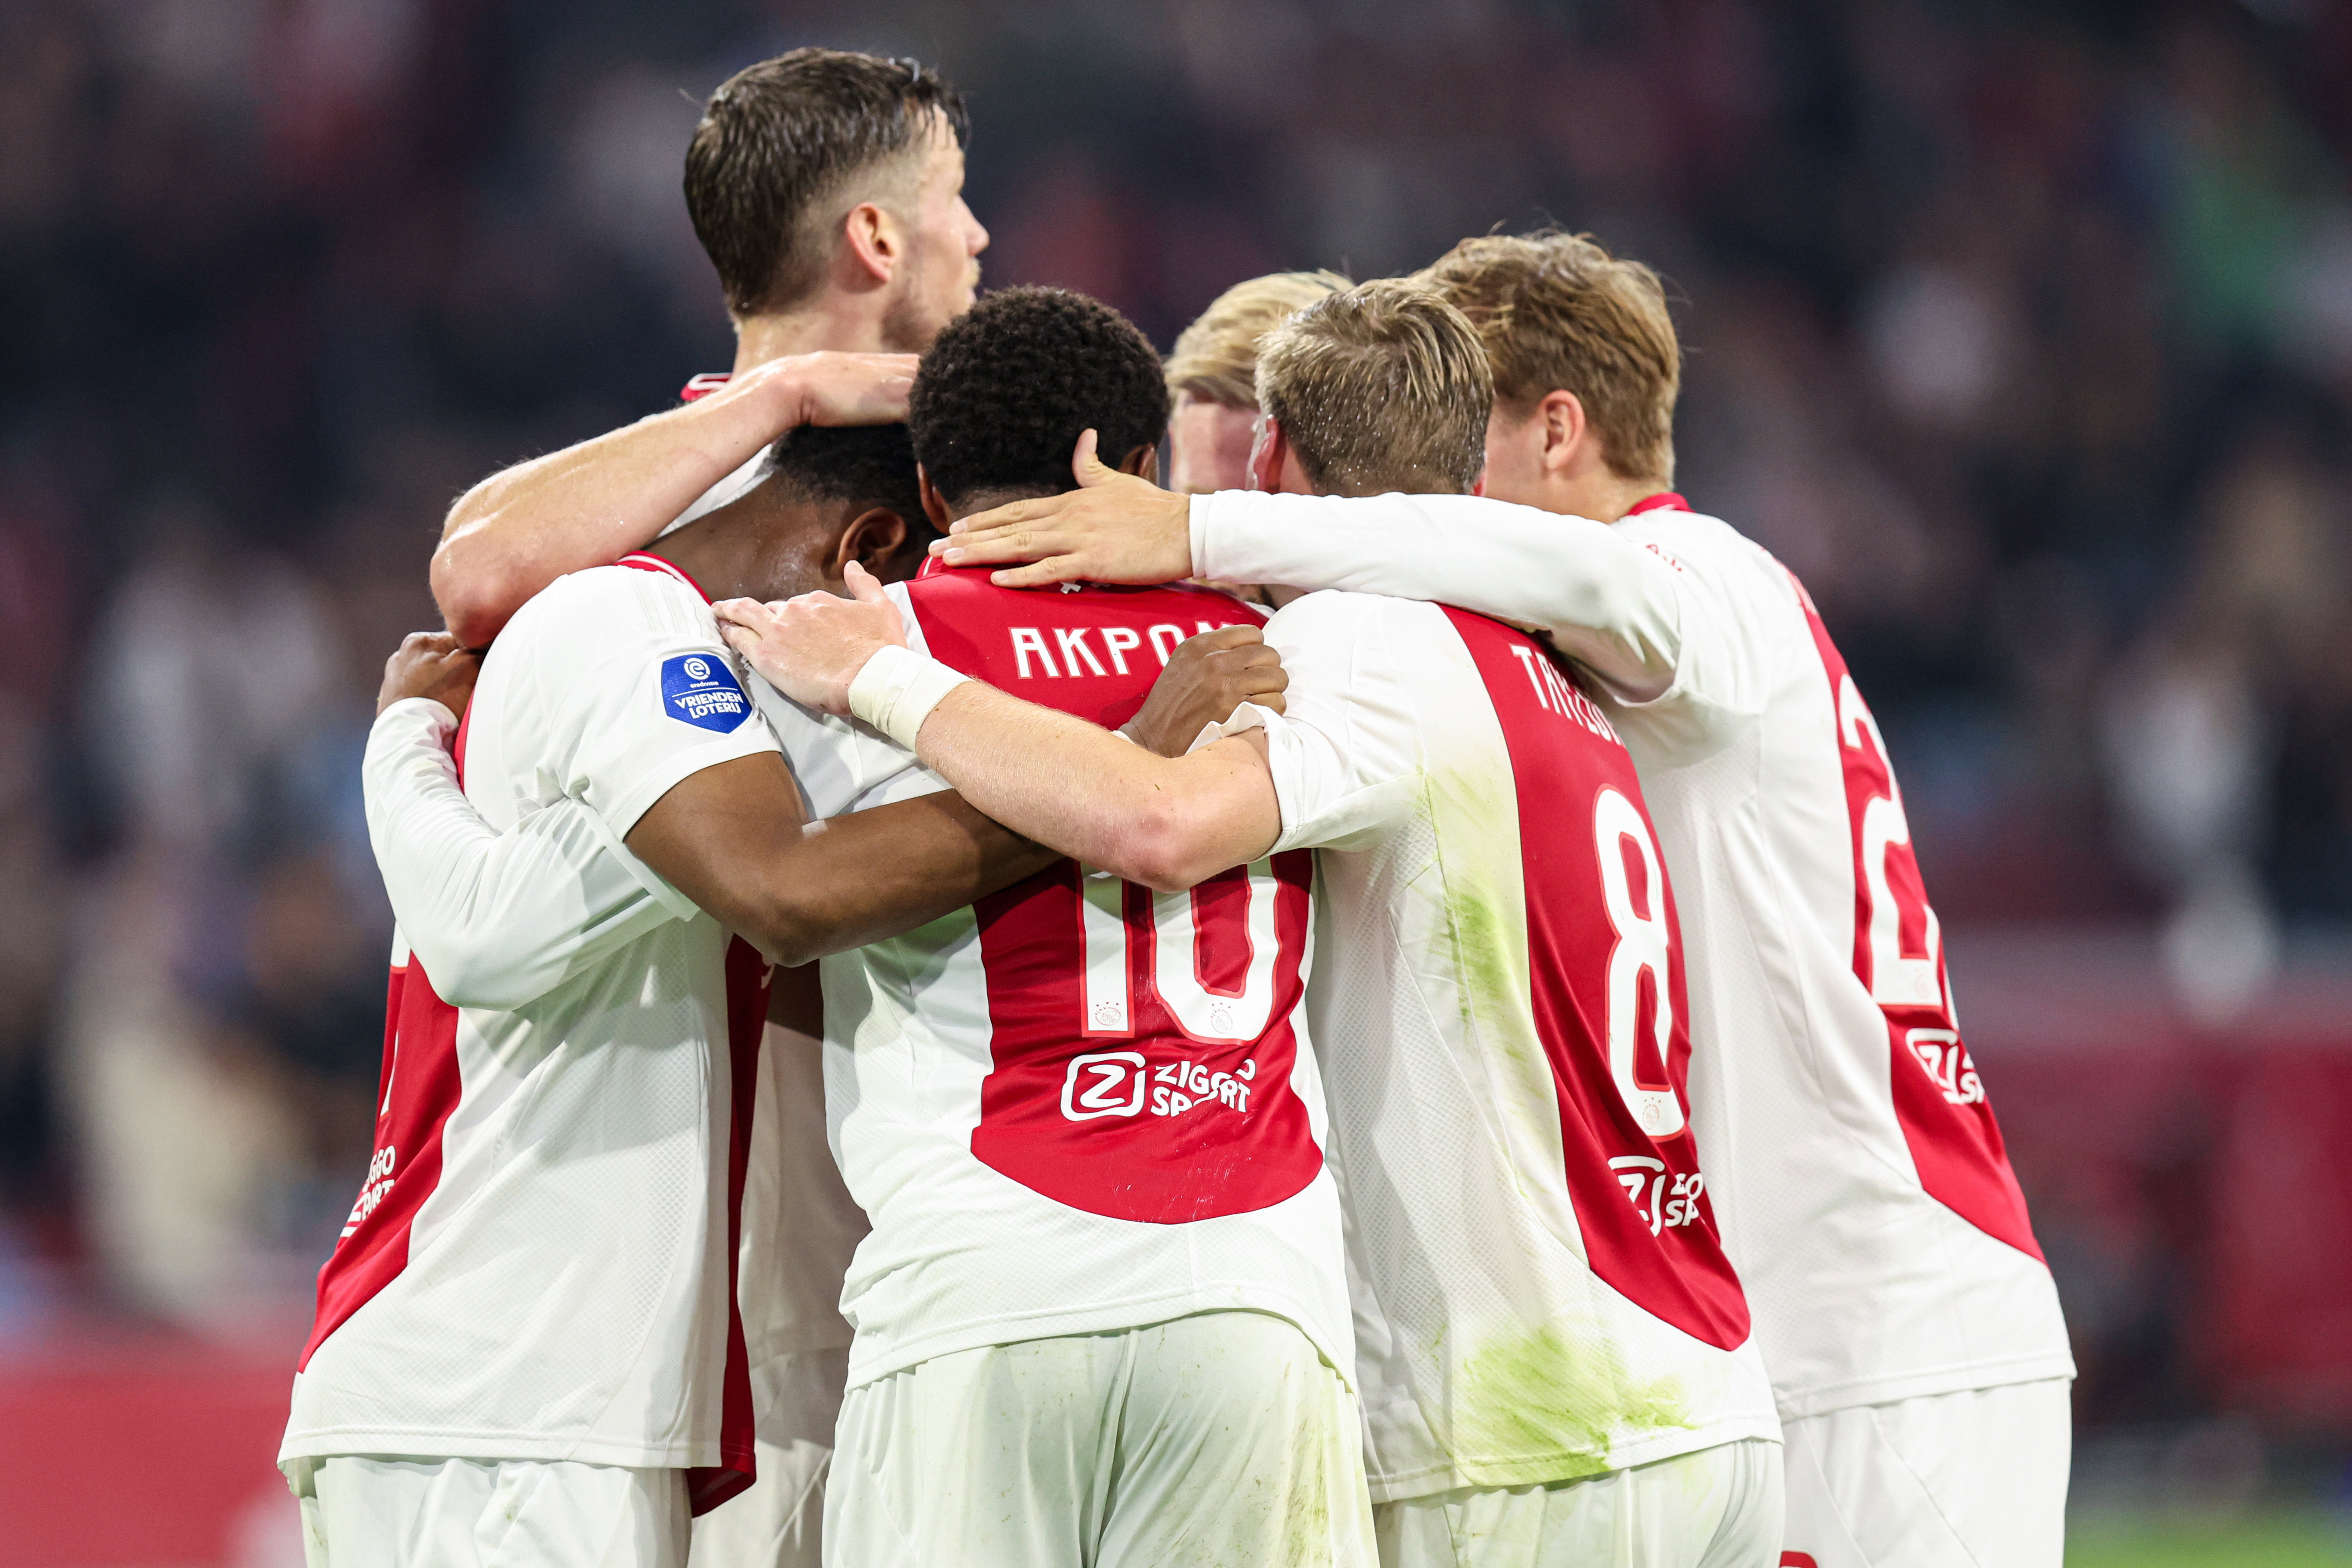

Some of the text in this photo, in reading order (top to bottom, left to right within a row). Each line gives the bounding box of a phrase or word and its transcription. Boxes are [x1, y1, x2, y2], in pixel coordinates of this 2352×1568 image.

[674, 692, 744, 708] VRIENDEN
[689, 702, 742, 719] LOTERIJ
[1008, 620, 1236, 679] AKPO
[1838, 673, 1959, 1032] 2
[1076, 855, 1281, 1045] 10
[1592, 783, 1685, 1142] 8
